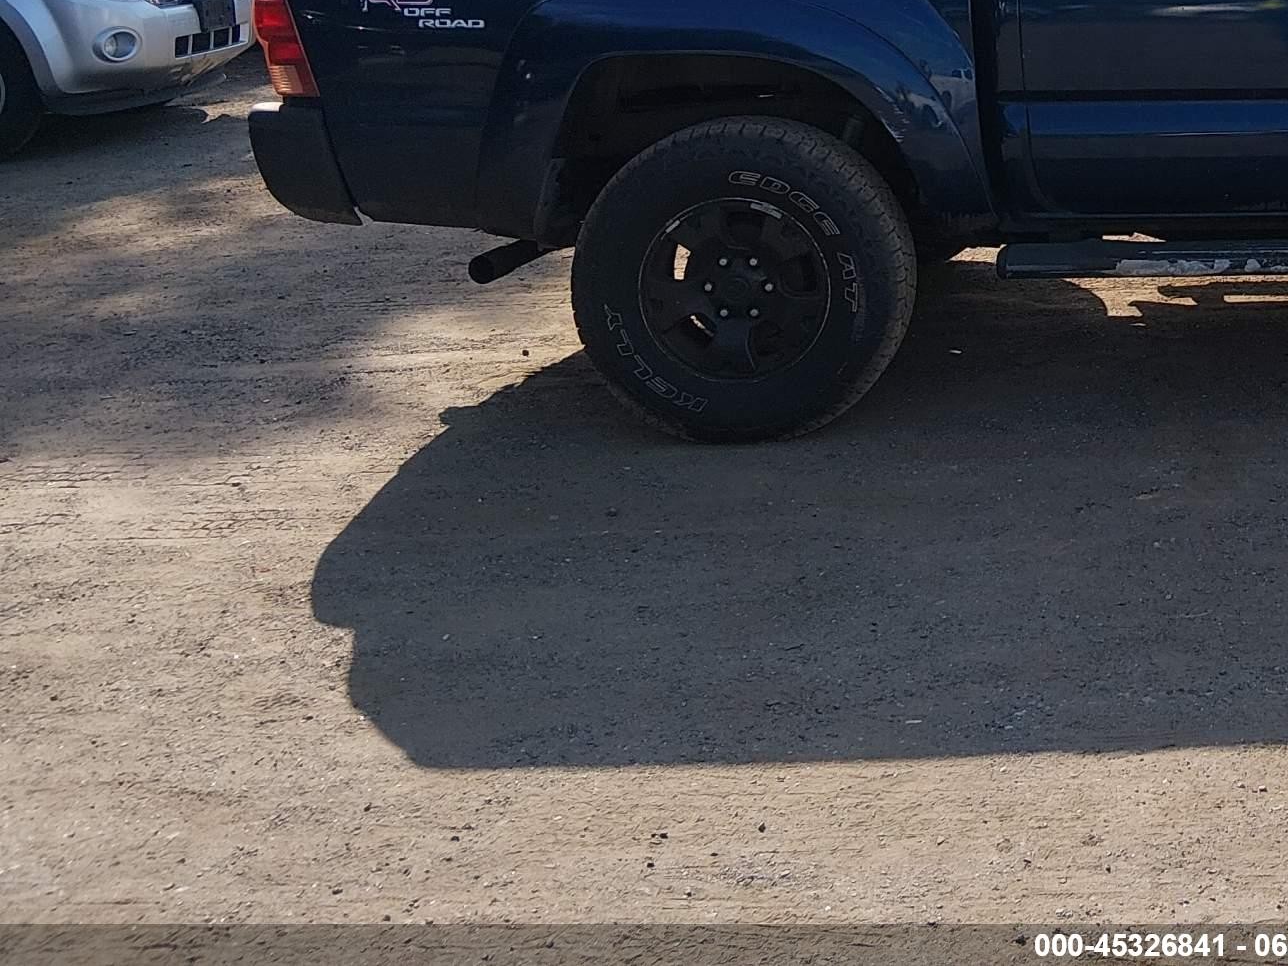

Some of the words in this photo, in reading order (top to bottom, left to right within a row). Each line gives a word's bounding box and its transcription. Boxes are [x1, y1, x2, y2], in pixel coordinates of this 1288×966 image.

[403, 7, 452, 17] OFF
[418, 18, 486, 29] ROAD
[728, 170, 841, 236] EDGE
[603, 303, 708, 412] KELLY
